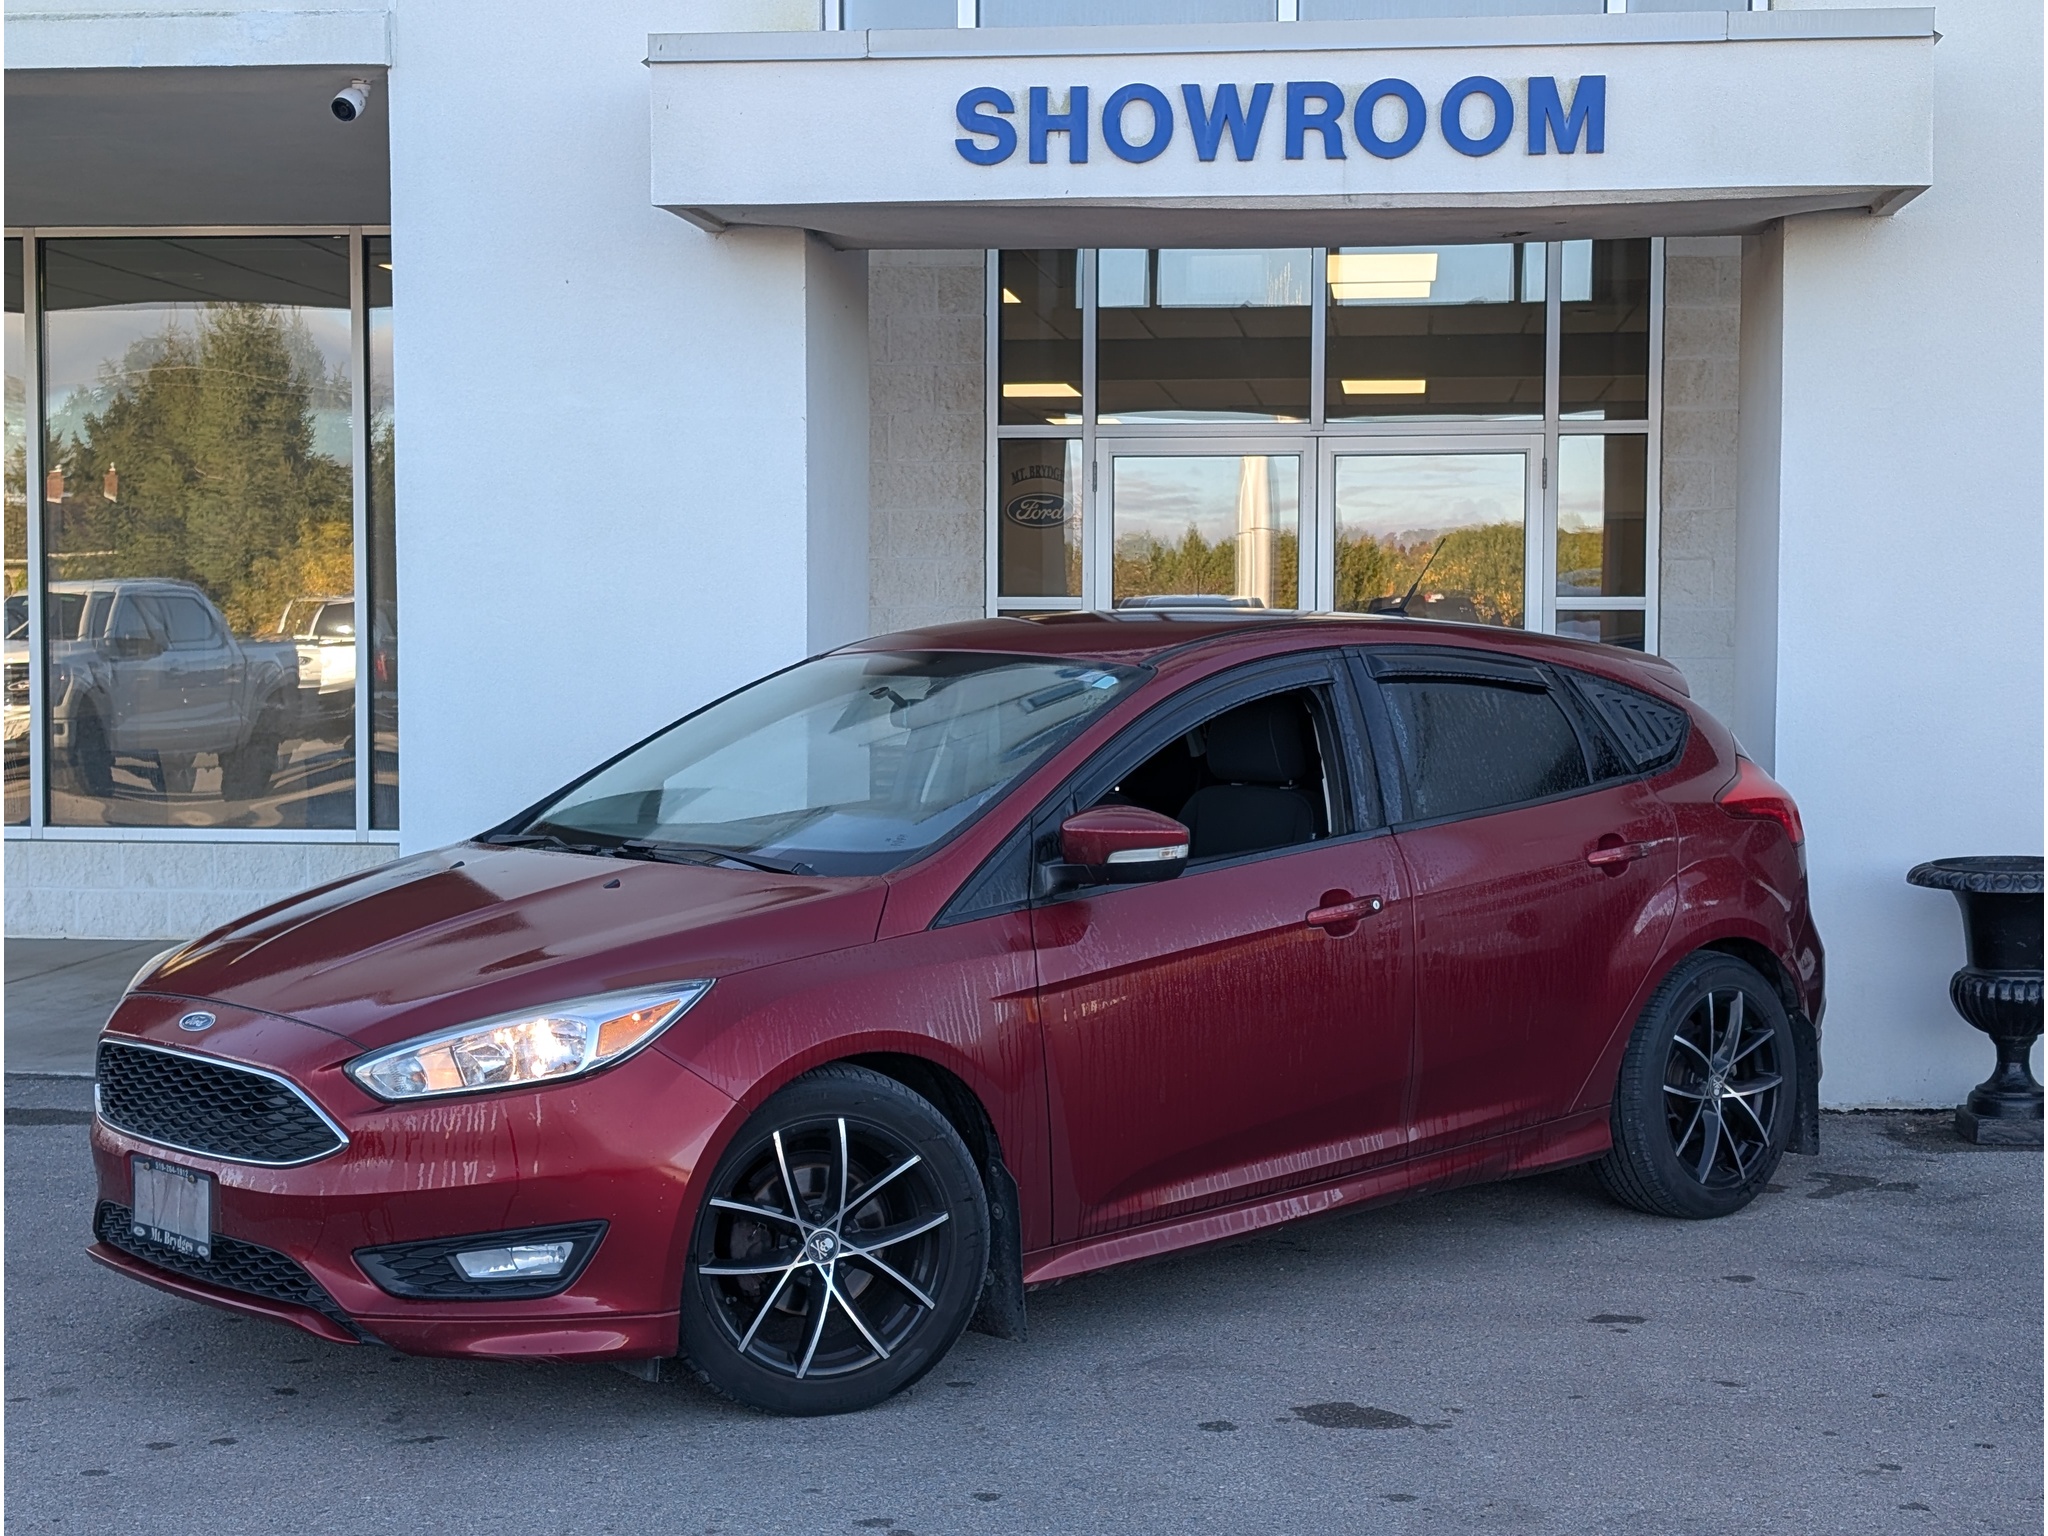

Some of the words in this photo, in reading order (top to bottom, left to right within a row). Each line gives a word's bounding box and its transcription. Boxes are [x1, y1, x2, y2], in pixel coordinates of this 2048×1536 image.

[955, 75, 1607, 164] SHOWROOM
[1011, 467, 1027, 485] MT.
[1016, 499, 1066, 519] Ford
[151, 1227, 163, 1243] Mt.
[164, 1231, 194, 1252] Brydges
